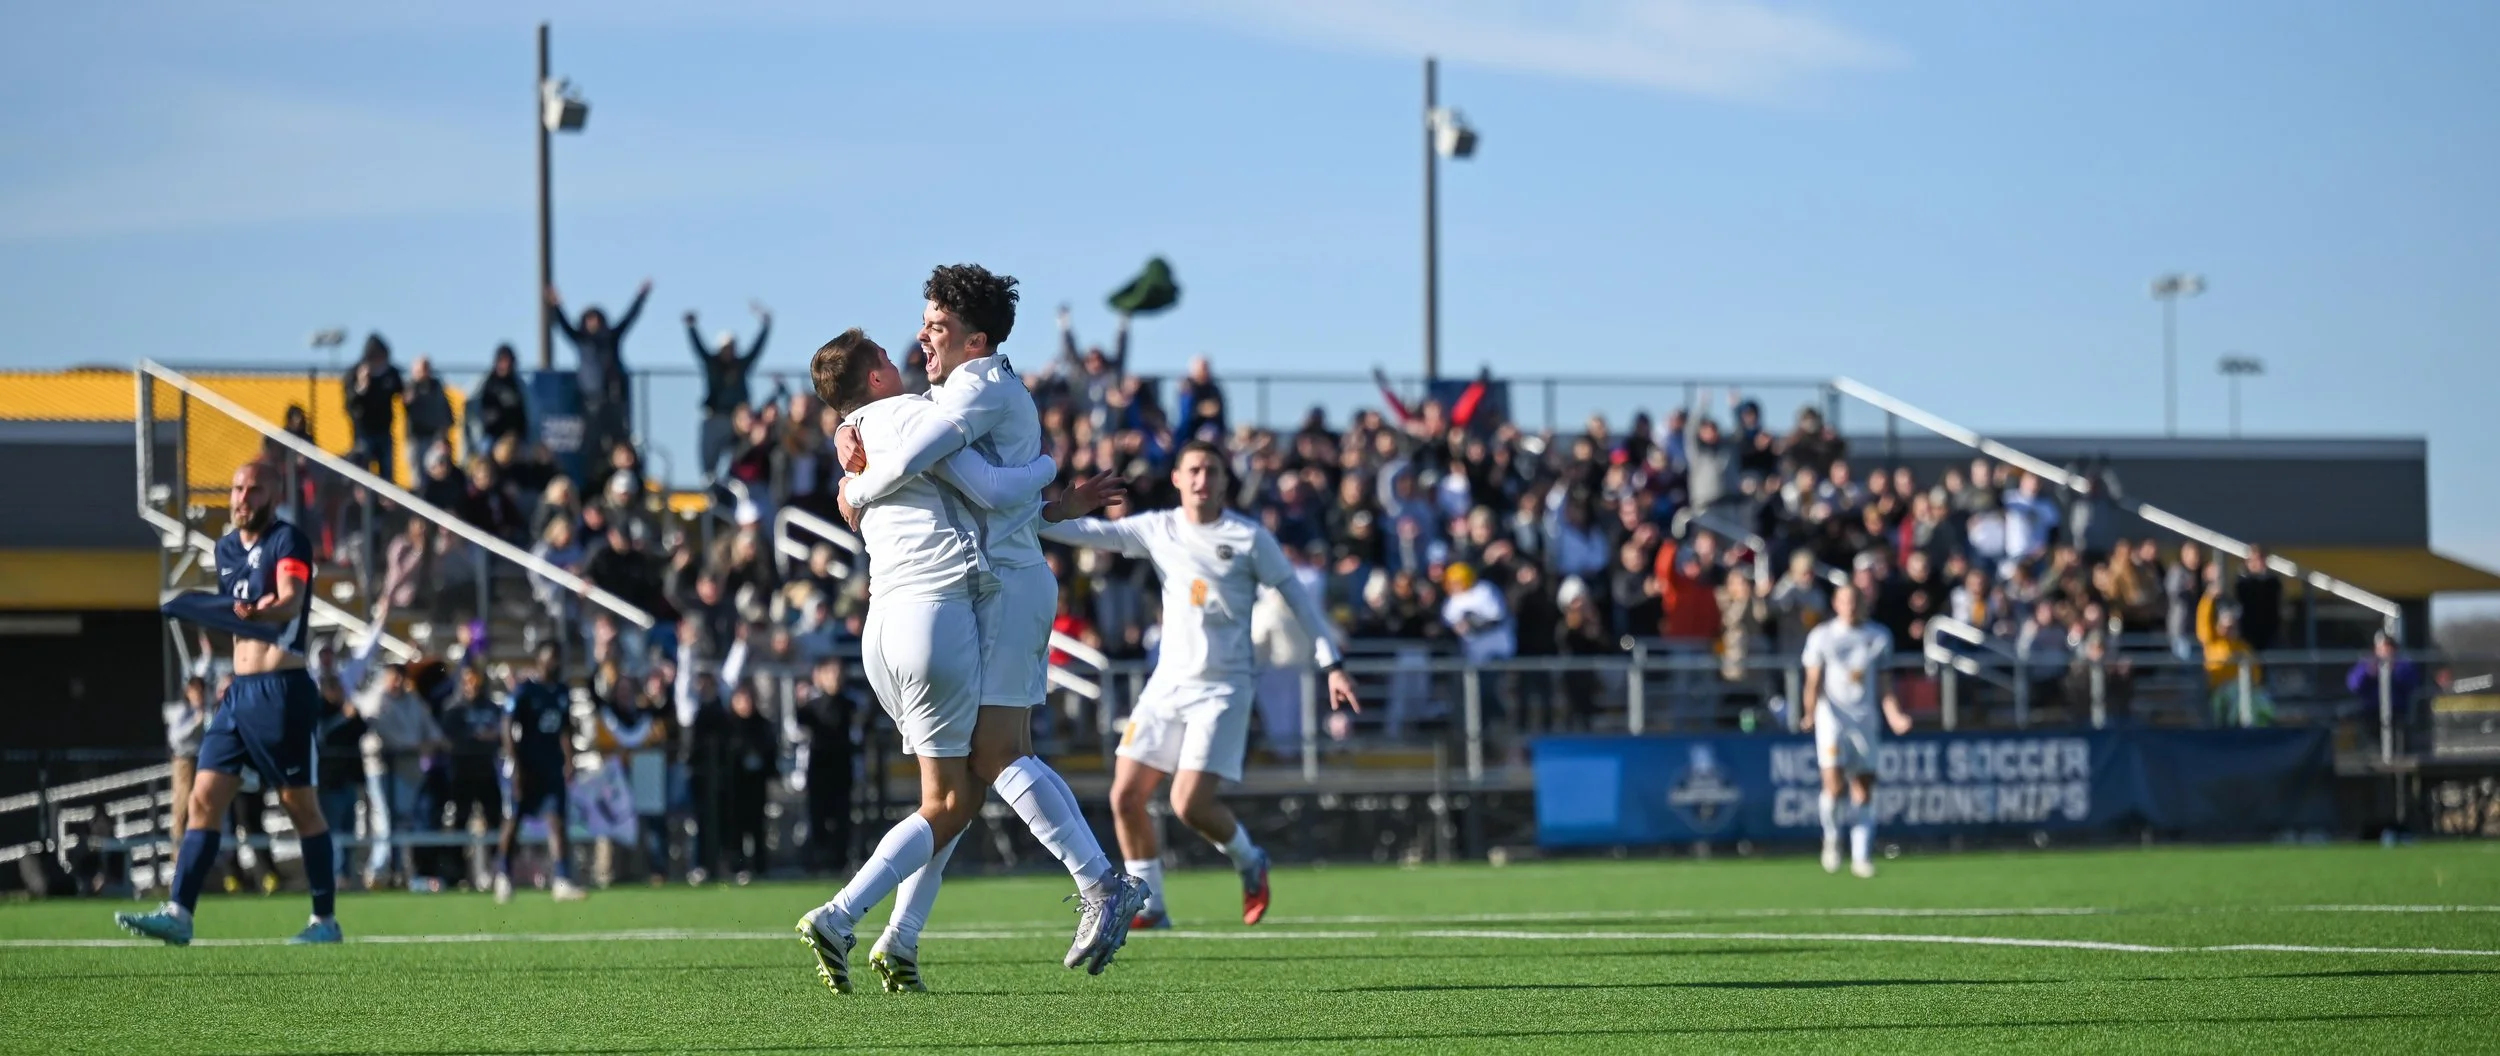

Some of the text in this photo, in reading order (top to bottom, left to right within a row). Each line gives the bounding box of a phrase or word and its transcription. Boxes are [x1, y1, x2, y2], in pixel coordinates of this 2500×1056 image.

[1771, 738, 2089, 785] NC DII SOCCER
[1774, 781, 2089, 827] CHPIONSHIPS
